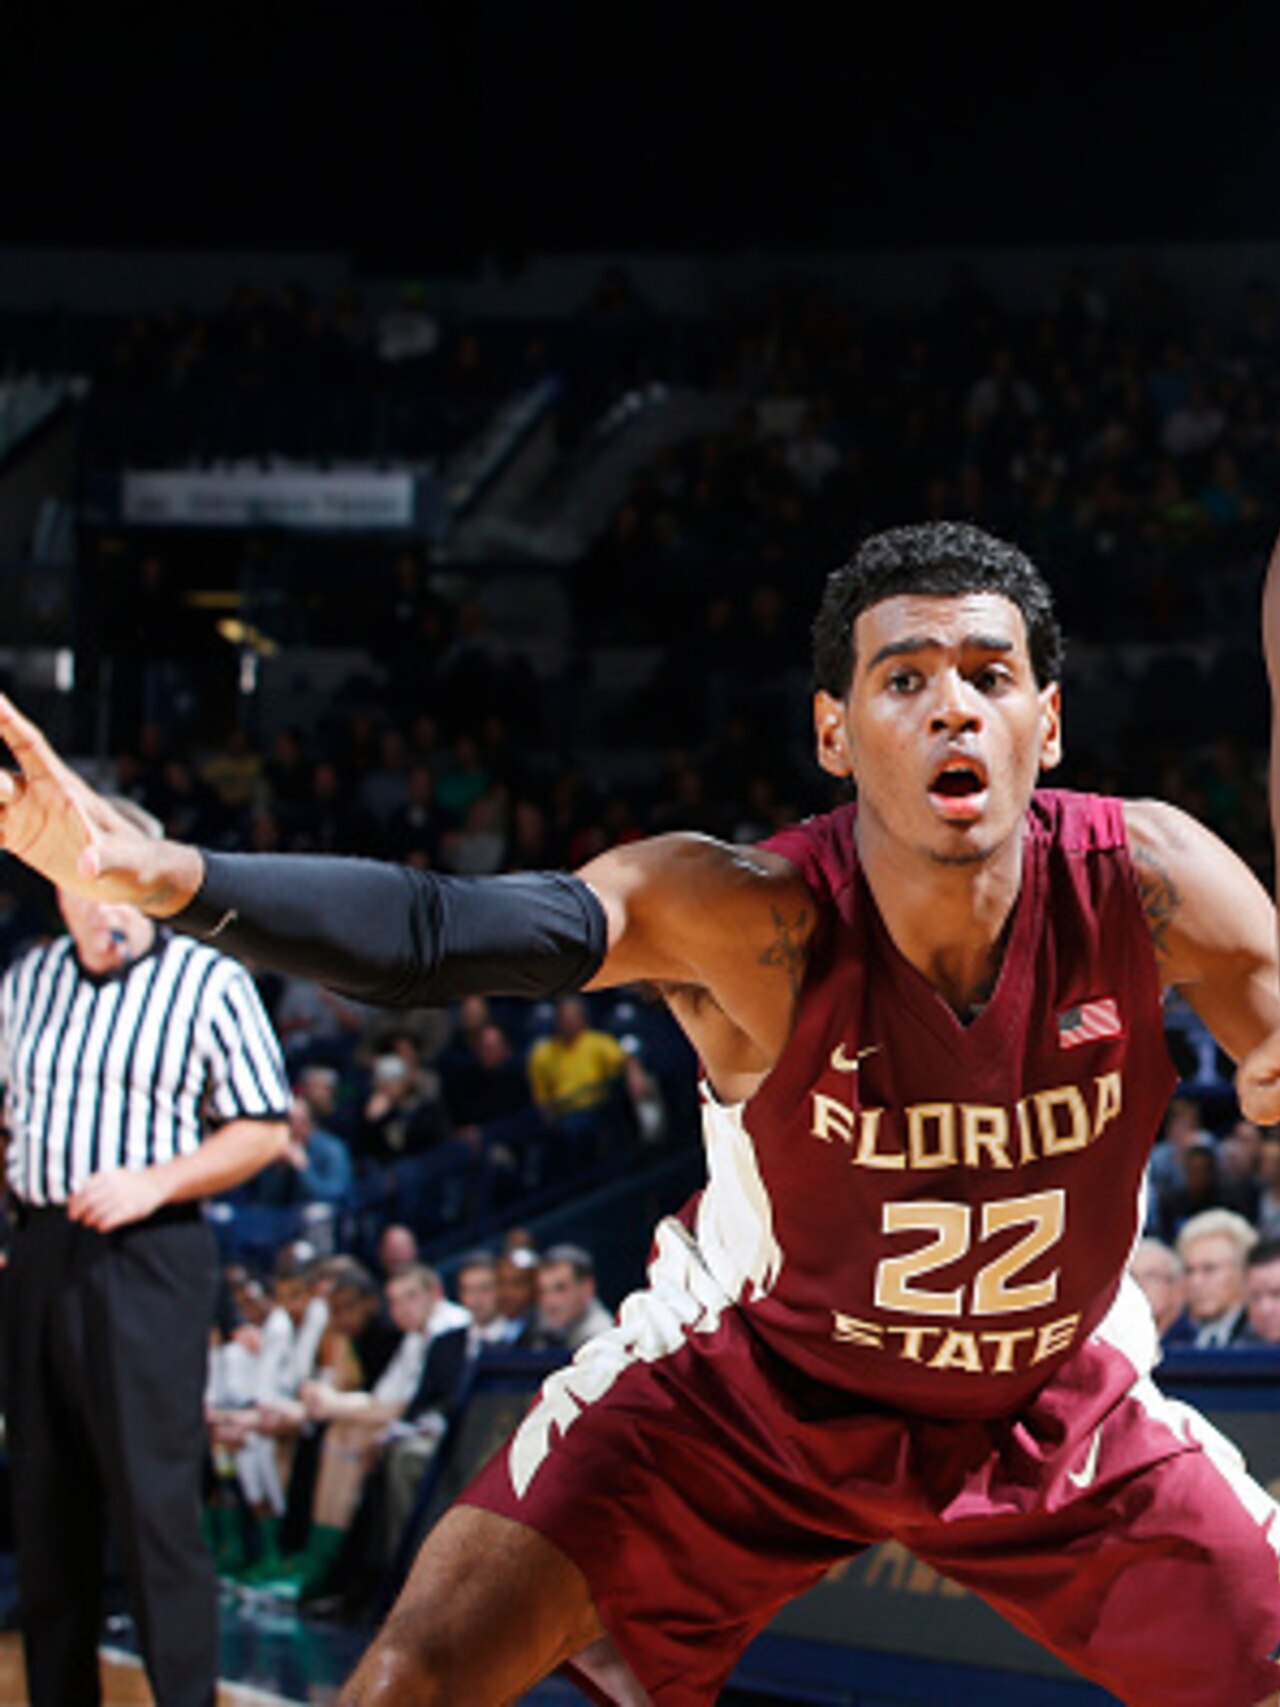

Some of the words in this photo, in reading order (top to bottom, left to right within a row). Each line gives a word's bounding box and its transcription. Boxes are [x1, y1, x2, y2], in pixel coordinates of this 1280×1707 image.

[810, 1070, 1122, 1170] FLORIDA
[873, 1188, 1066, 1317] 22
[831, 1309, 1082, 1374] STATE
